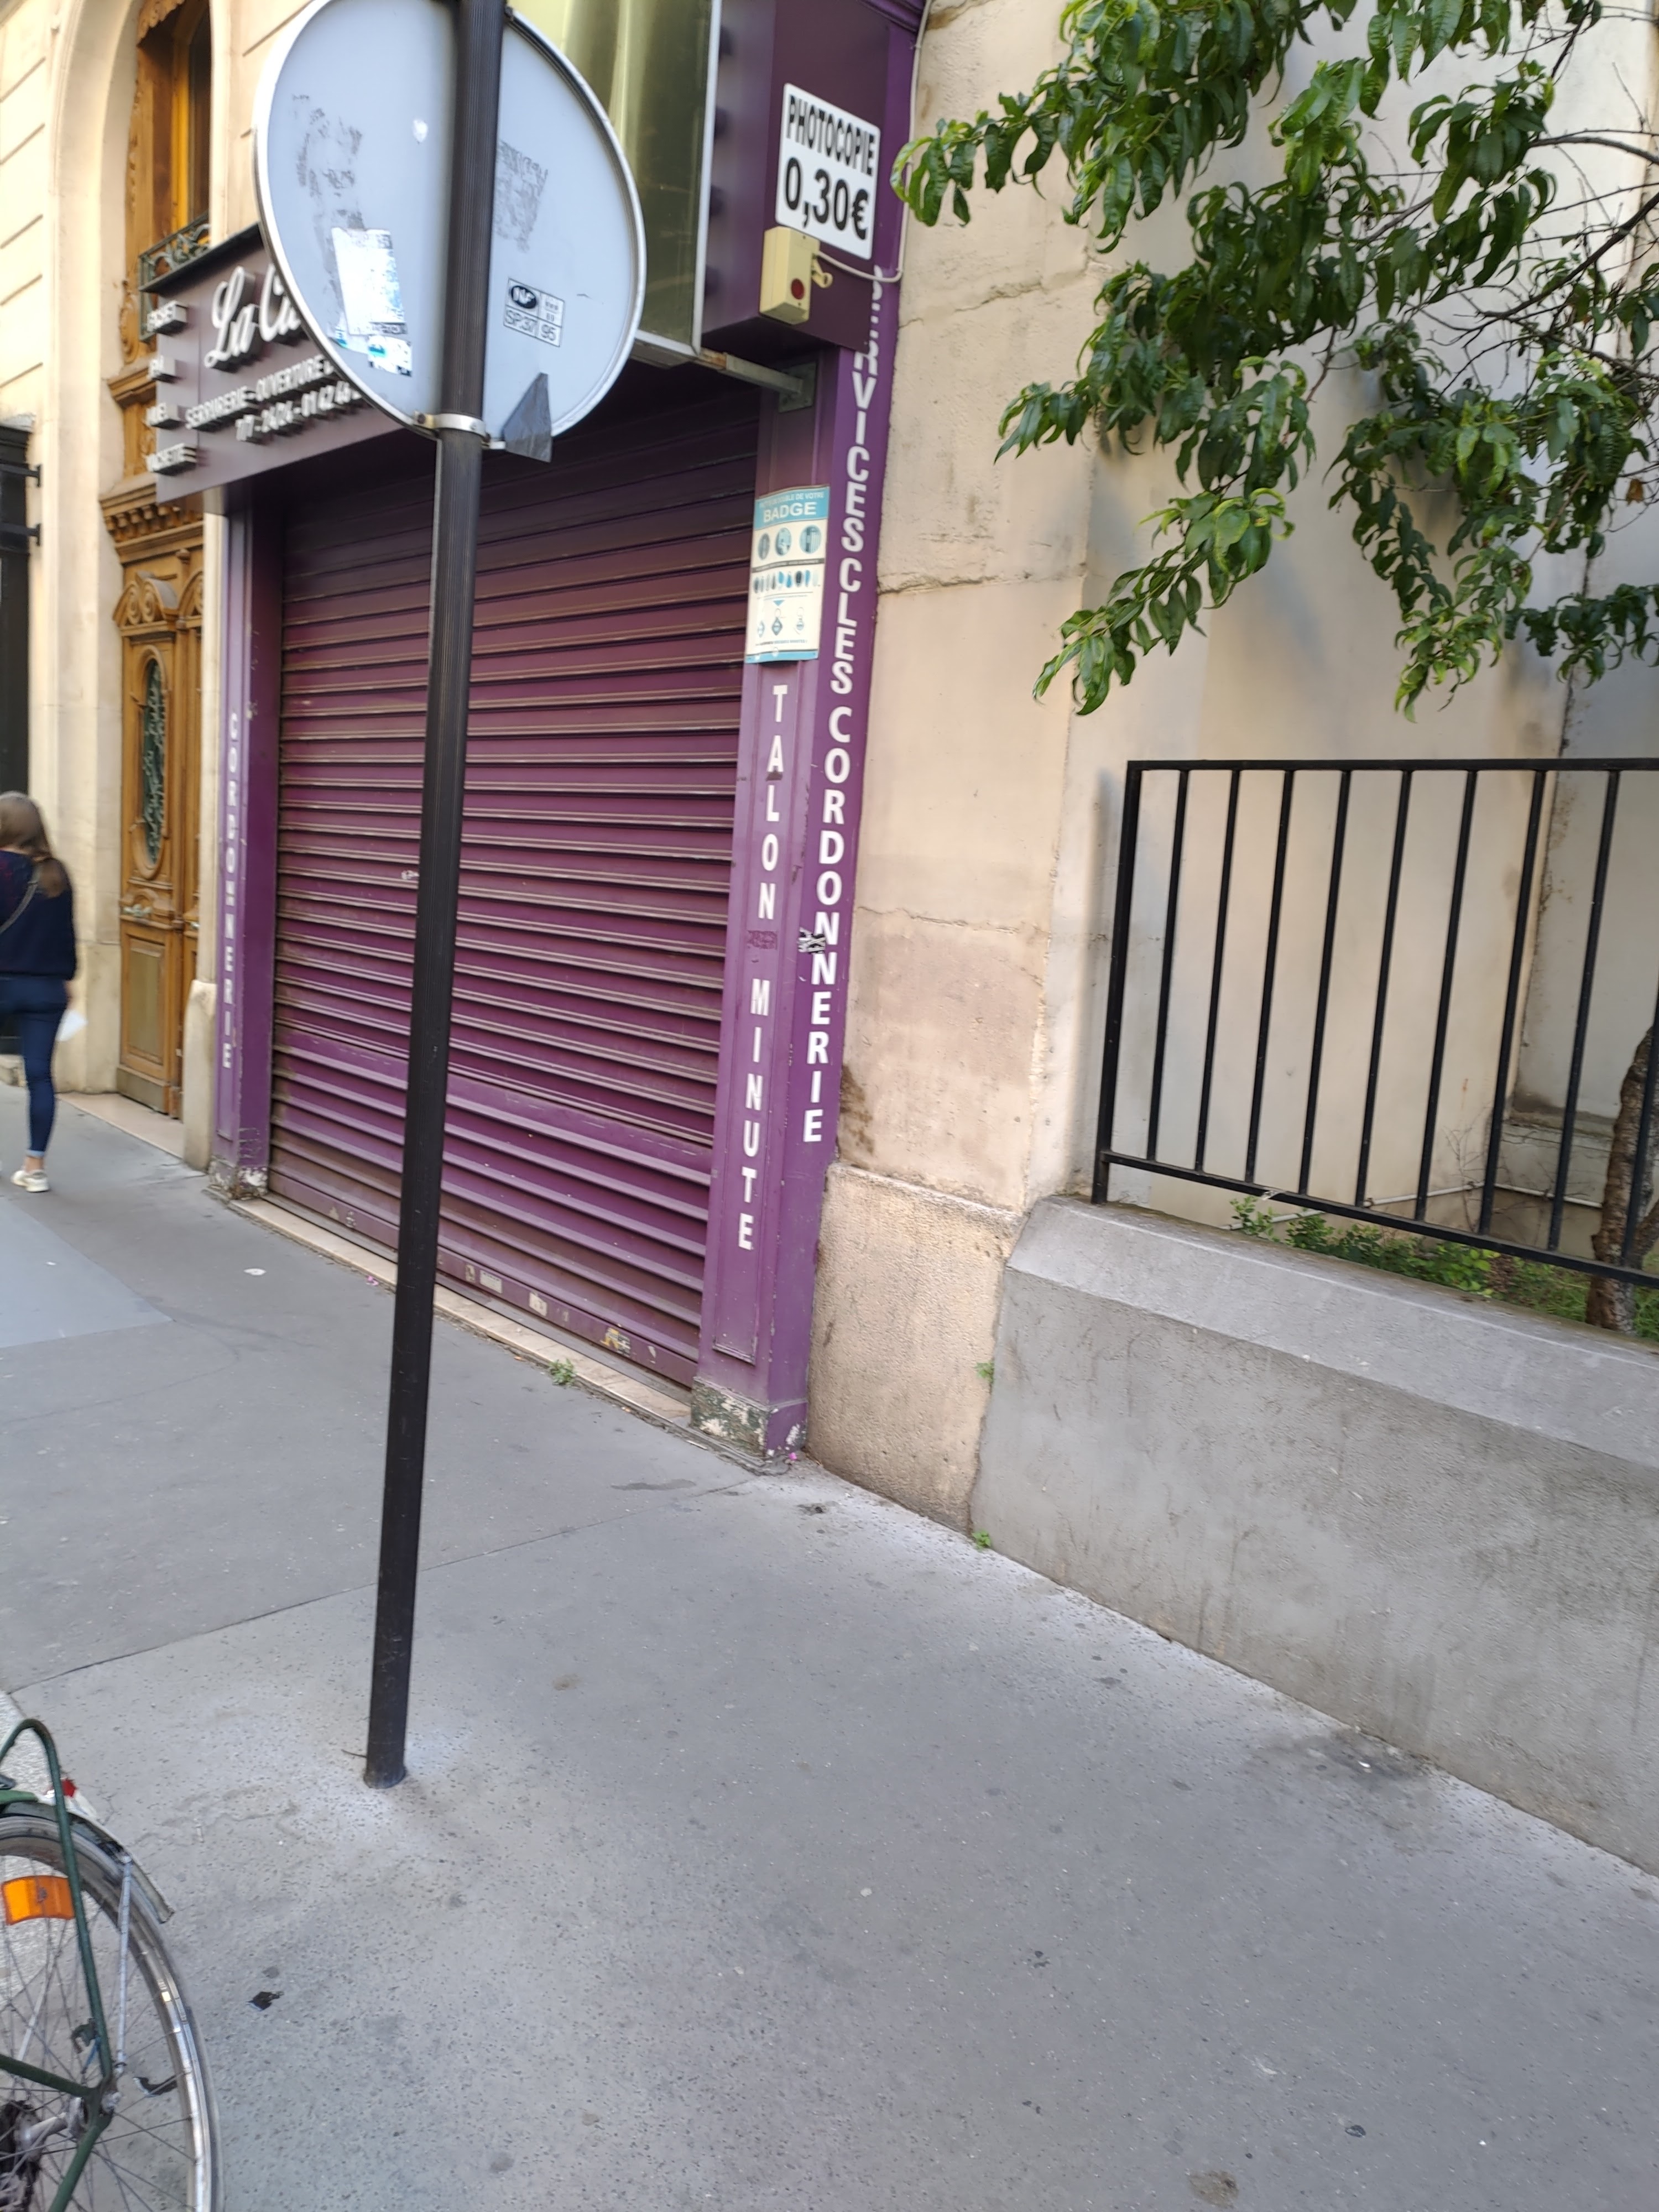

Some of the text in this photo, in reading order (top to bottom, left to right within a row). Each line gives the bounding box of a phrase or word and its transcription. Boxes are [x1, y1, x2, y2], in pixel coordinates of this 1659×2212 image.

[787, 95, 875, 176] PHOTOCOPIE
[785, 157, 869, 241] 0,30€
[764, 501, 817, 523] BADGE
[830, 557, 863, 695] CLES
[738, 685, 788, 1250] TALON MINUTE
[803, 706, 852, 1142] CORDONNERIE
